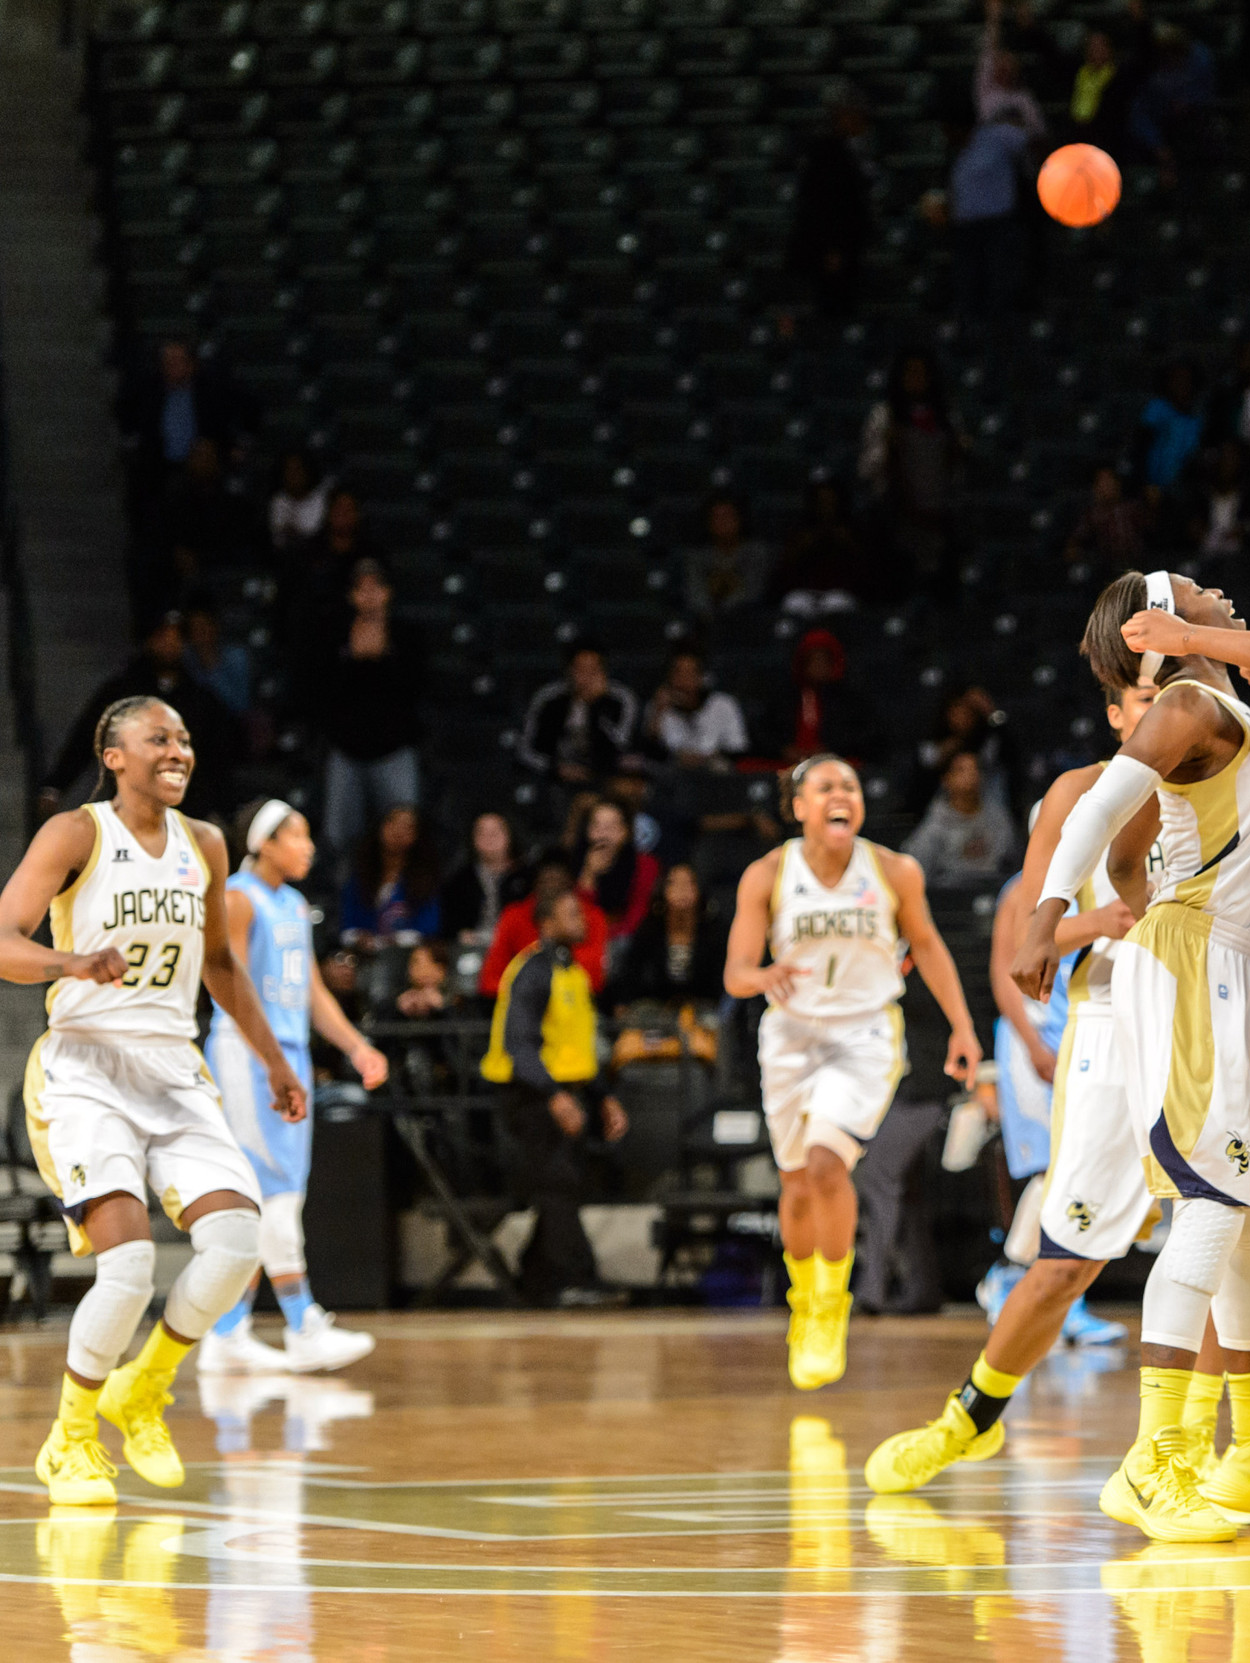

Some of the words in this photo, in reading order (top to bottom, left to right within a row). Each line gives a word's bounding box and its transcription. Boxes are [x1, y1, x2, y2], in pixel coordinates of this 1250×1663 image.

[792, 908, 876, 941] JACKETS
[121, 942, 182, 989] 23
[826, 954, 838, 987] 1
